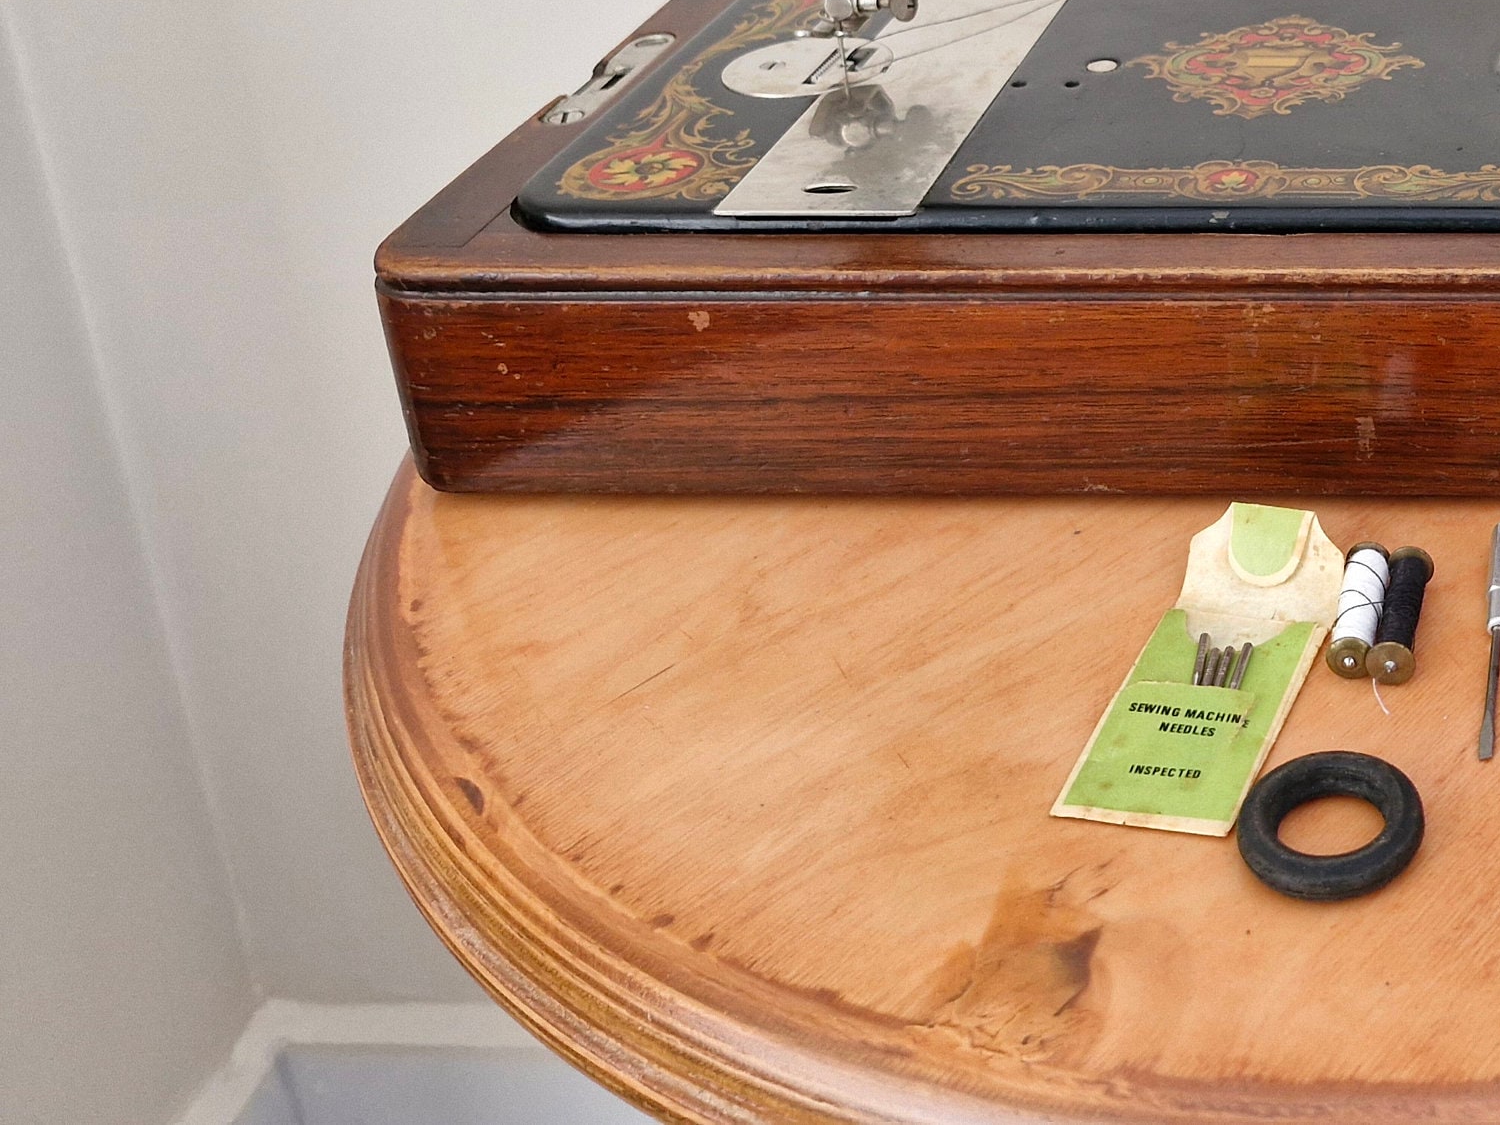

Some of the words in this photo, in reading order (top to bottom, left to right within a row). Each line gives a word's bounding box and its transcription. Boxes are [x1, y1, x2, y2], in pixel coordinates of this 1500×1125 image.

[1128, 702, 1181, 717] SEWING
[1184, 708, 1251, 729] MACHINE
[1158, 722, 1216, 737] NEEDLES
[1128, 764, 1202, 779] INSPECTED
